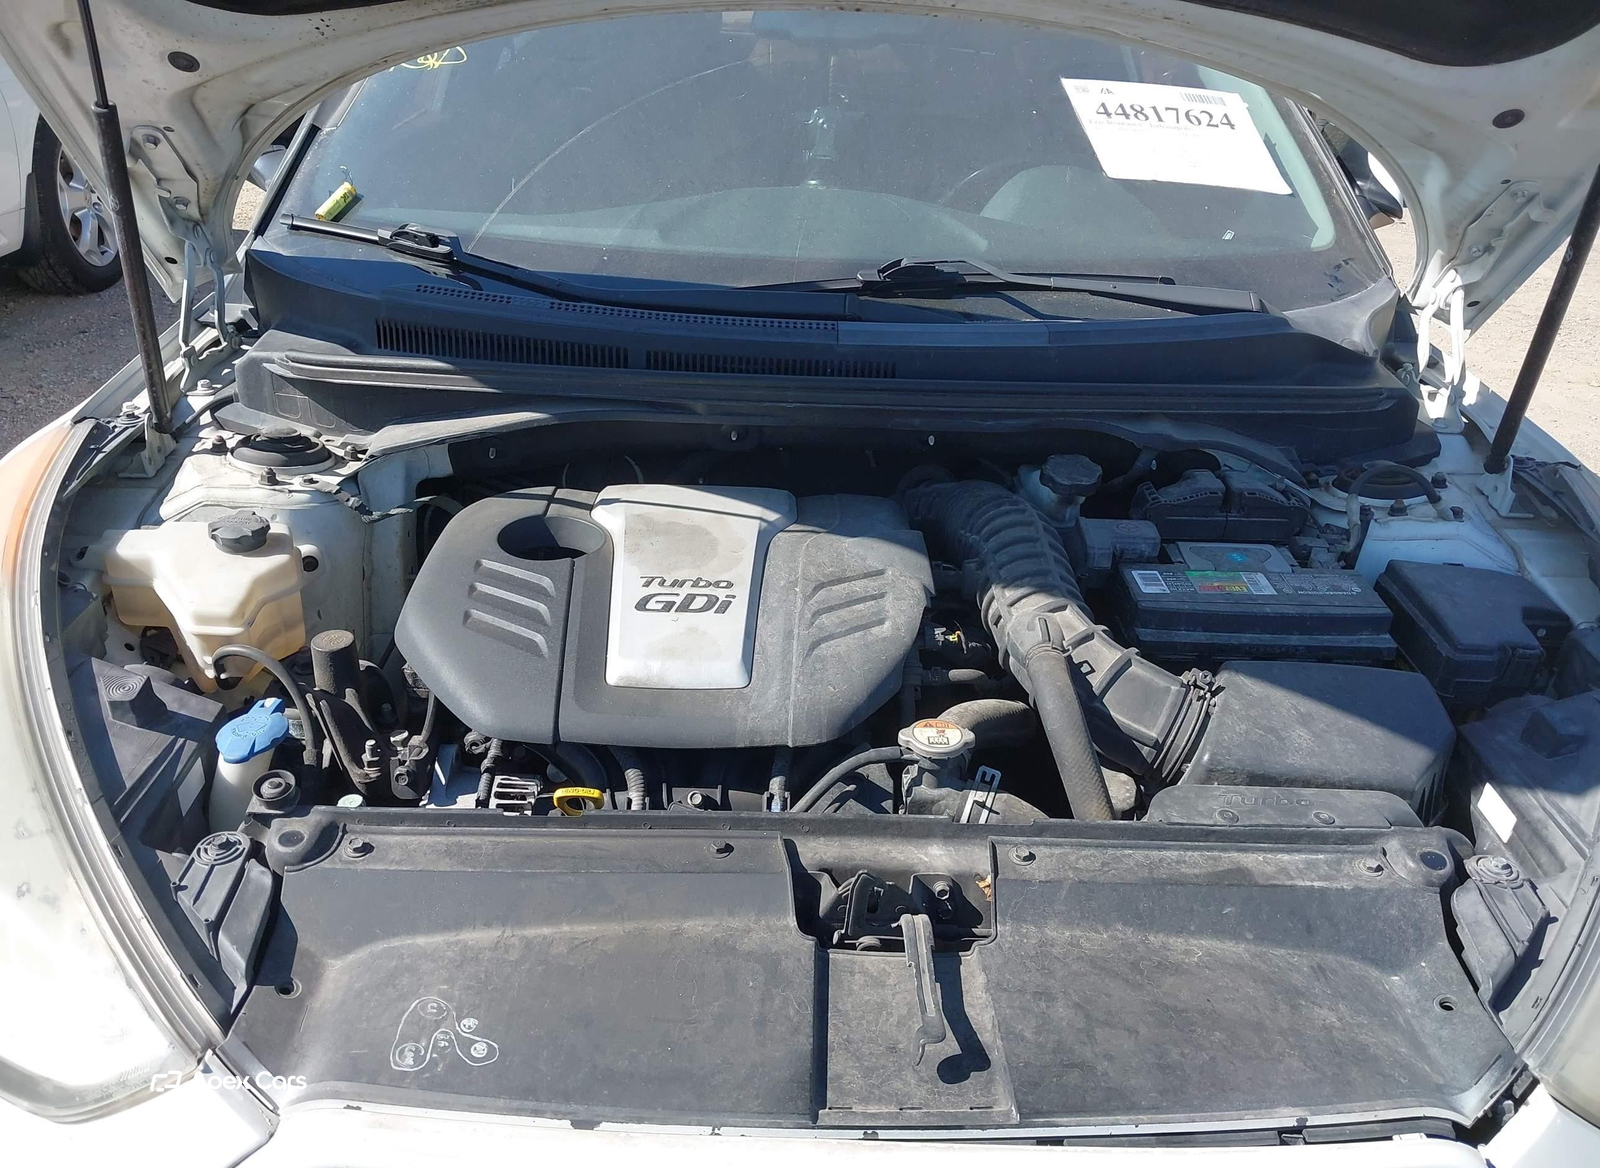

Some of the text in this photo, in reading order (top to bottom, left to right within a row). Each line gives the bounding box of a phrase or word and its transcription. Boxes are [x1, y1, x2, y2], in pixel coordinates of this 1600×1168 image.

[1096, 101, 1236, 130] 44817624
[640, 576, 734, 590] Turbo
[634, 592, 737, 615] GDi
[1218, 793, 1315, 807] Turbo
